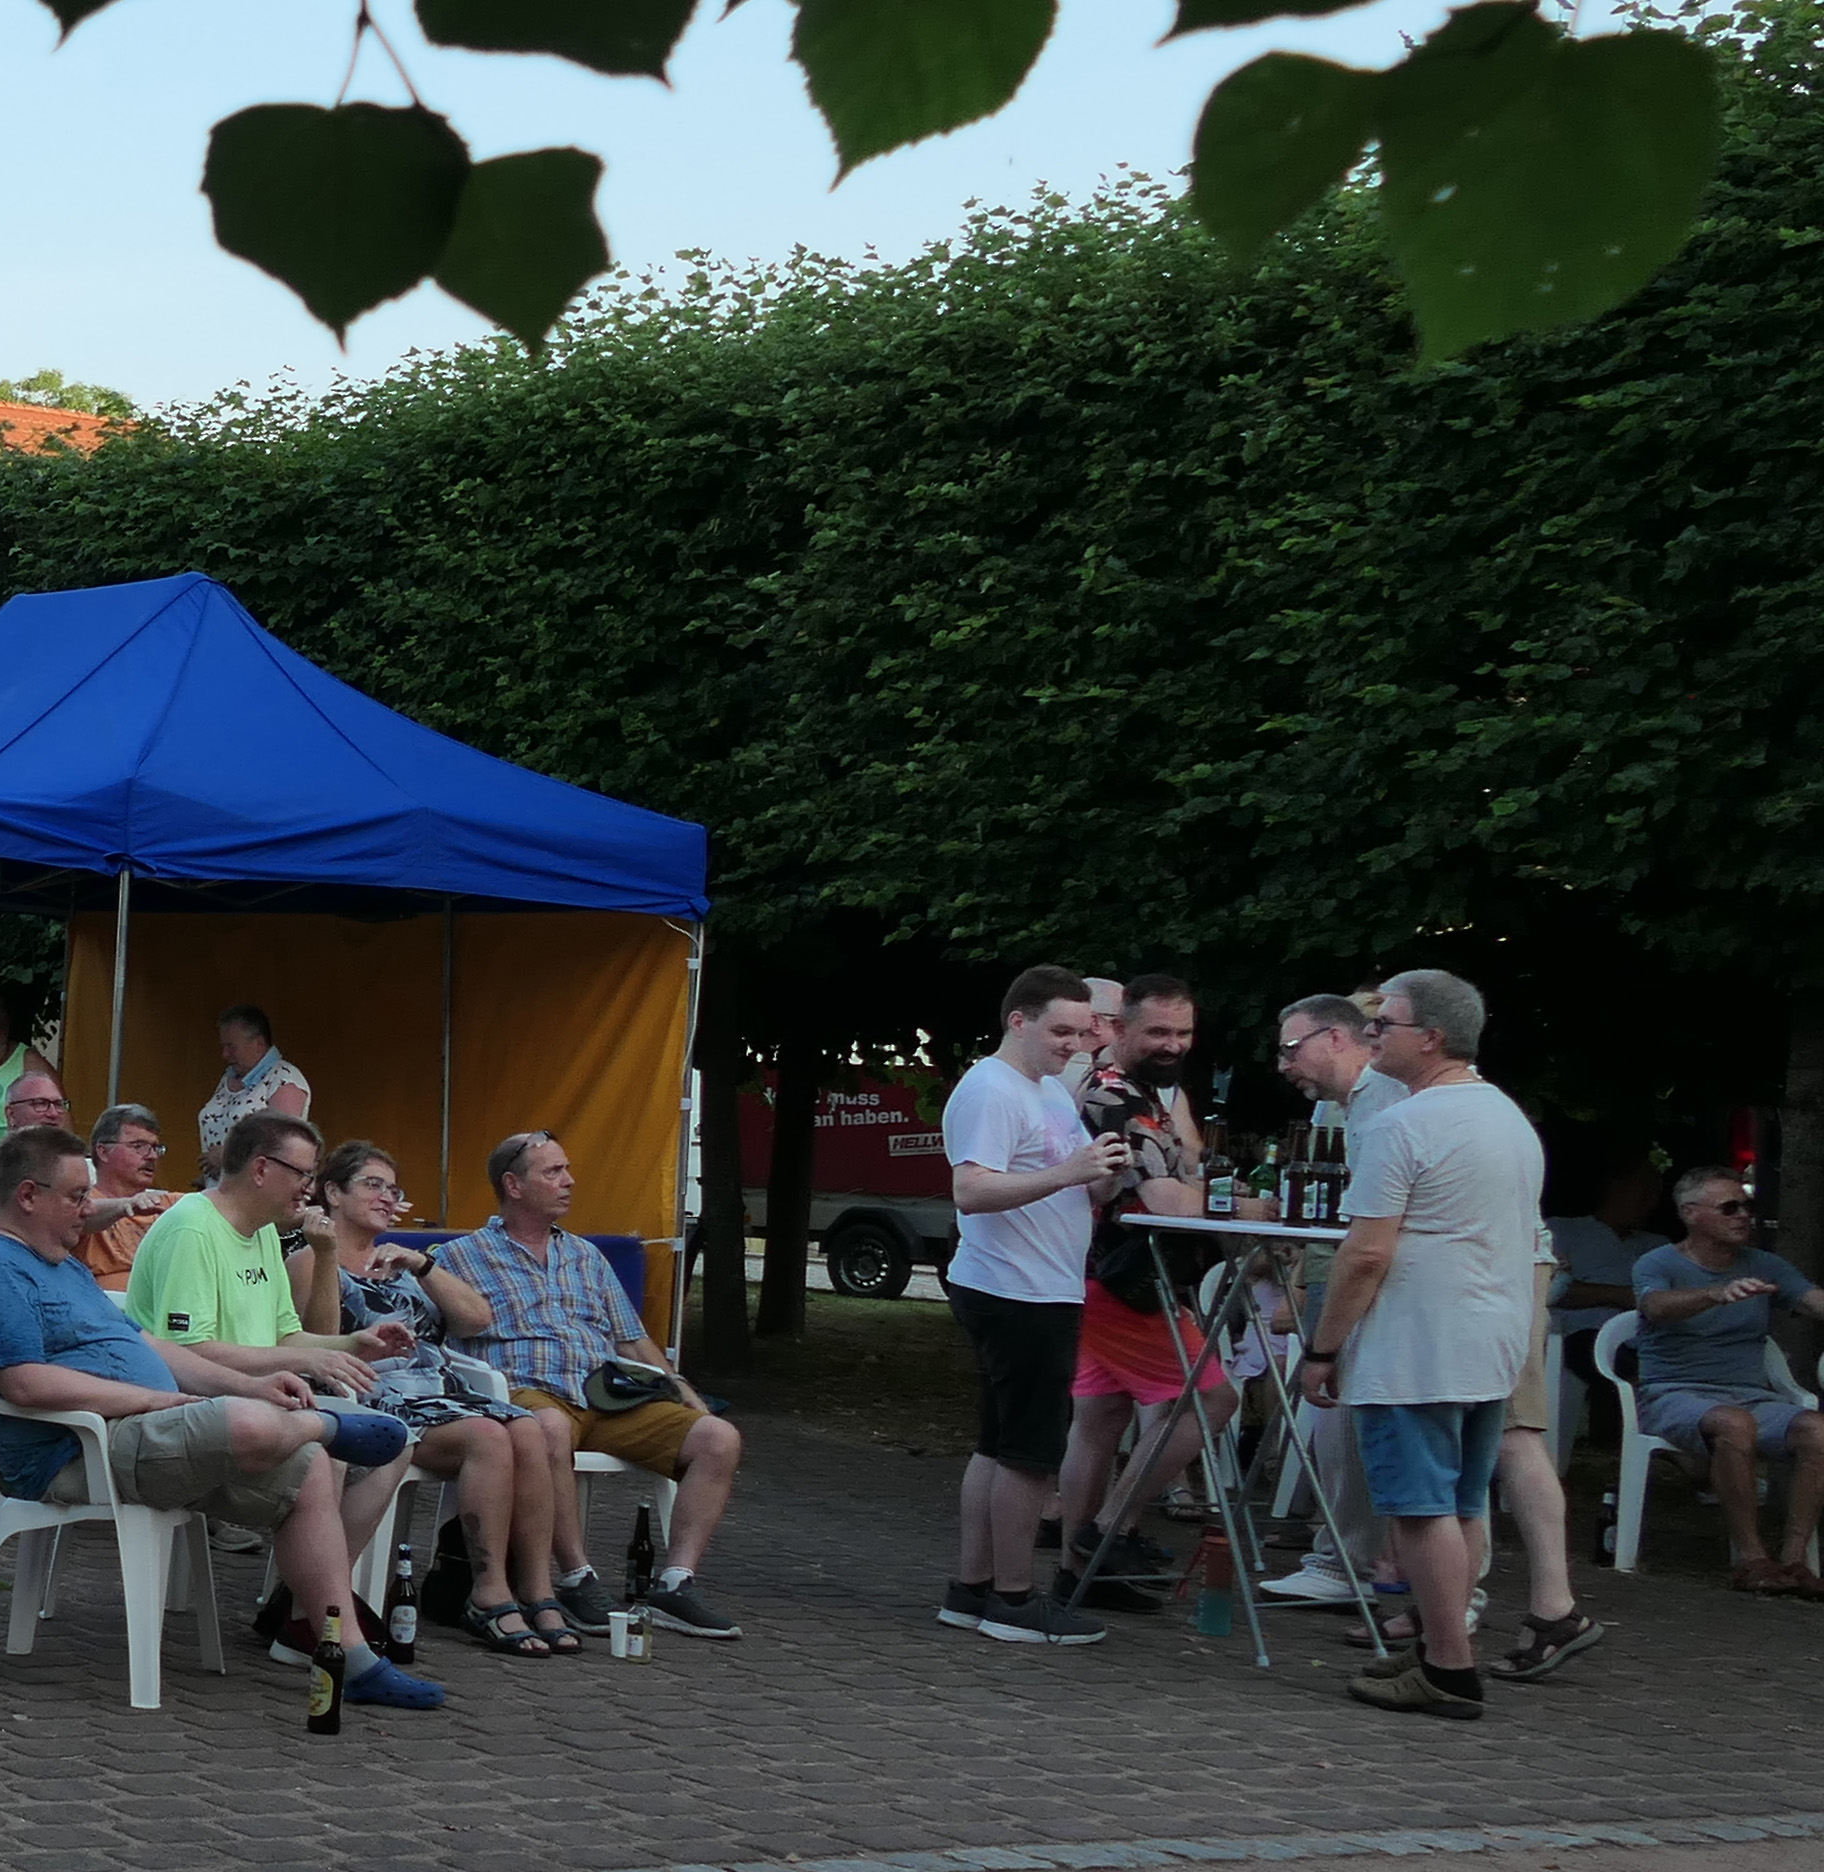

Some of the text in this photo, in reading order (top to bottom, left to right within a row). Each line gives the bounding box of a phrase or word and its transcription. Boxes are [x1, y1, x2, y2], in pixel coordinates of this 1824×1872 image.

[813, 1109, 909, 1128] an haben.
[893, 1135, 944, 1150] HELLW
